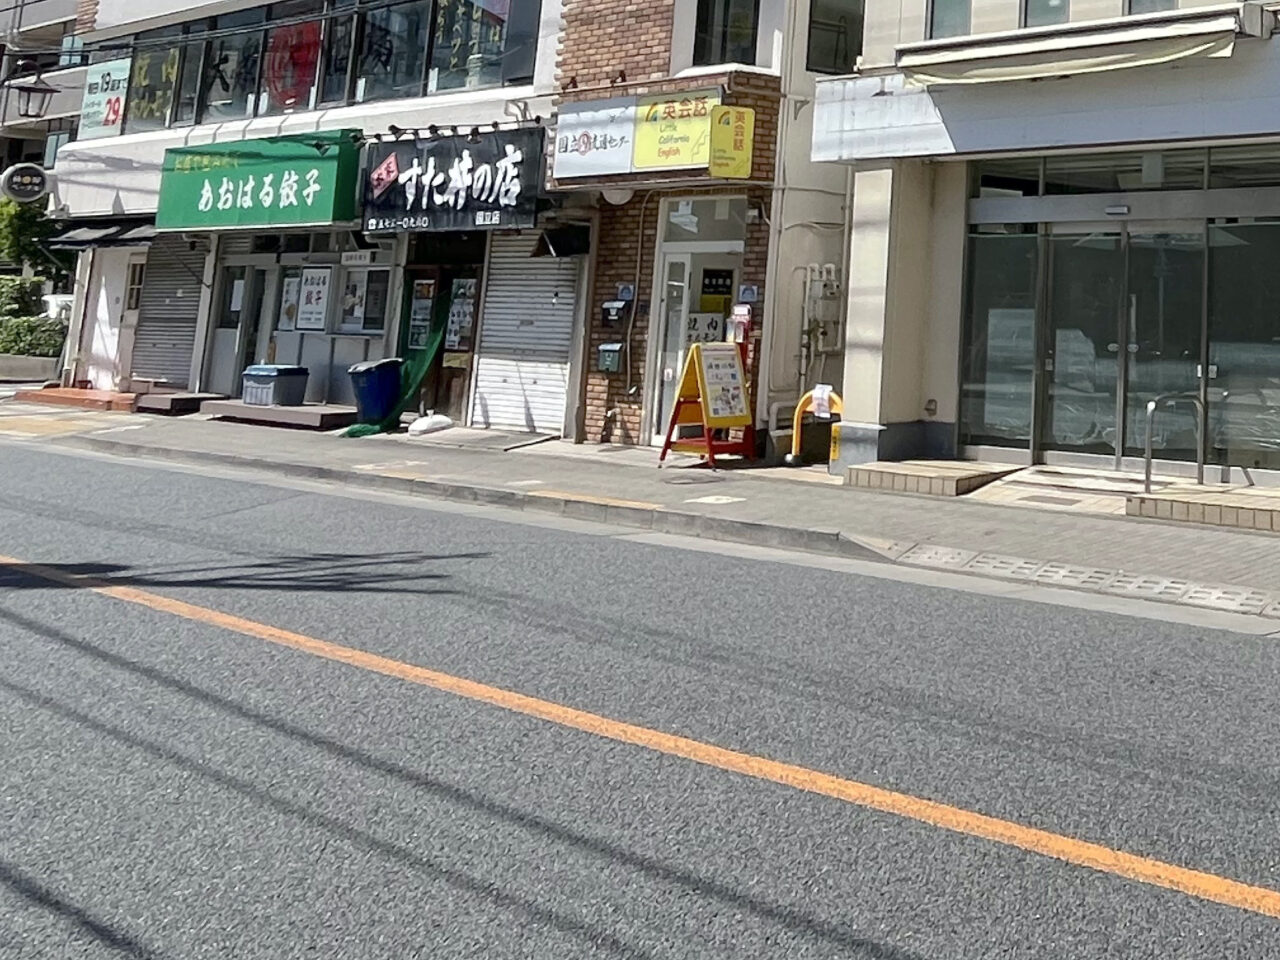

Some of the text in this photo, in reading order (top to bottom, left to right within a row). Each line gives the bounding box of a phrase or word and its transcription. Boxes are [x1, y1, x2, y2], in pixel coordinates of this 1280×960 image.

[662, 96, 708, 120] 英会話
[657, 147, 681, 157] English
[733, 111, 746, 152] 英会話
[199, 169, 321, 211] あおはる餃子
[399, 144, 522, 210] すた丼の店
